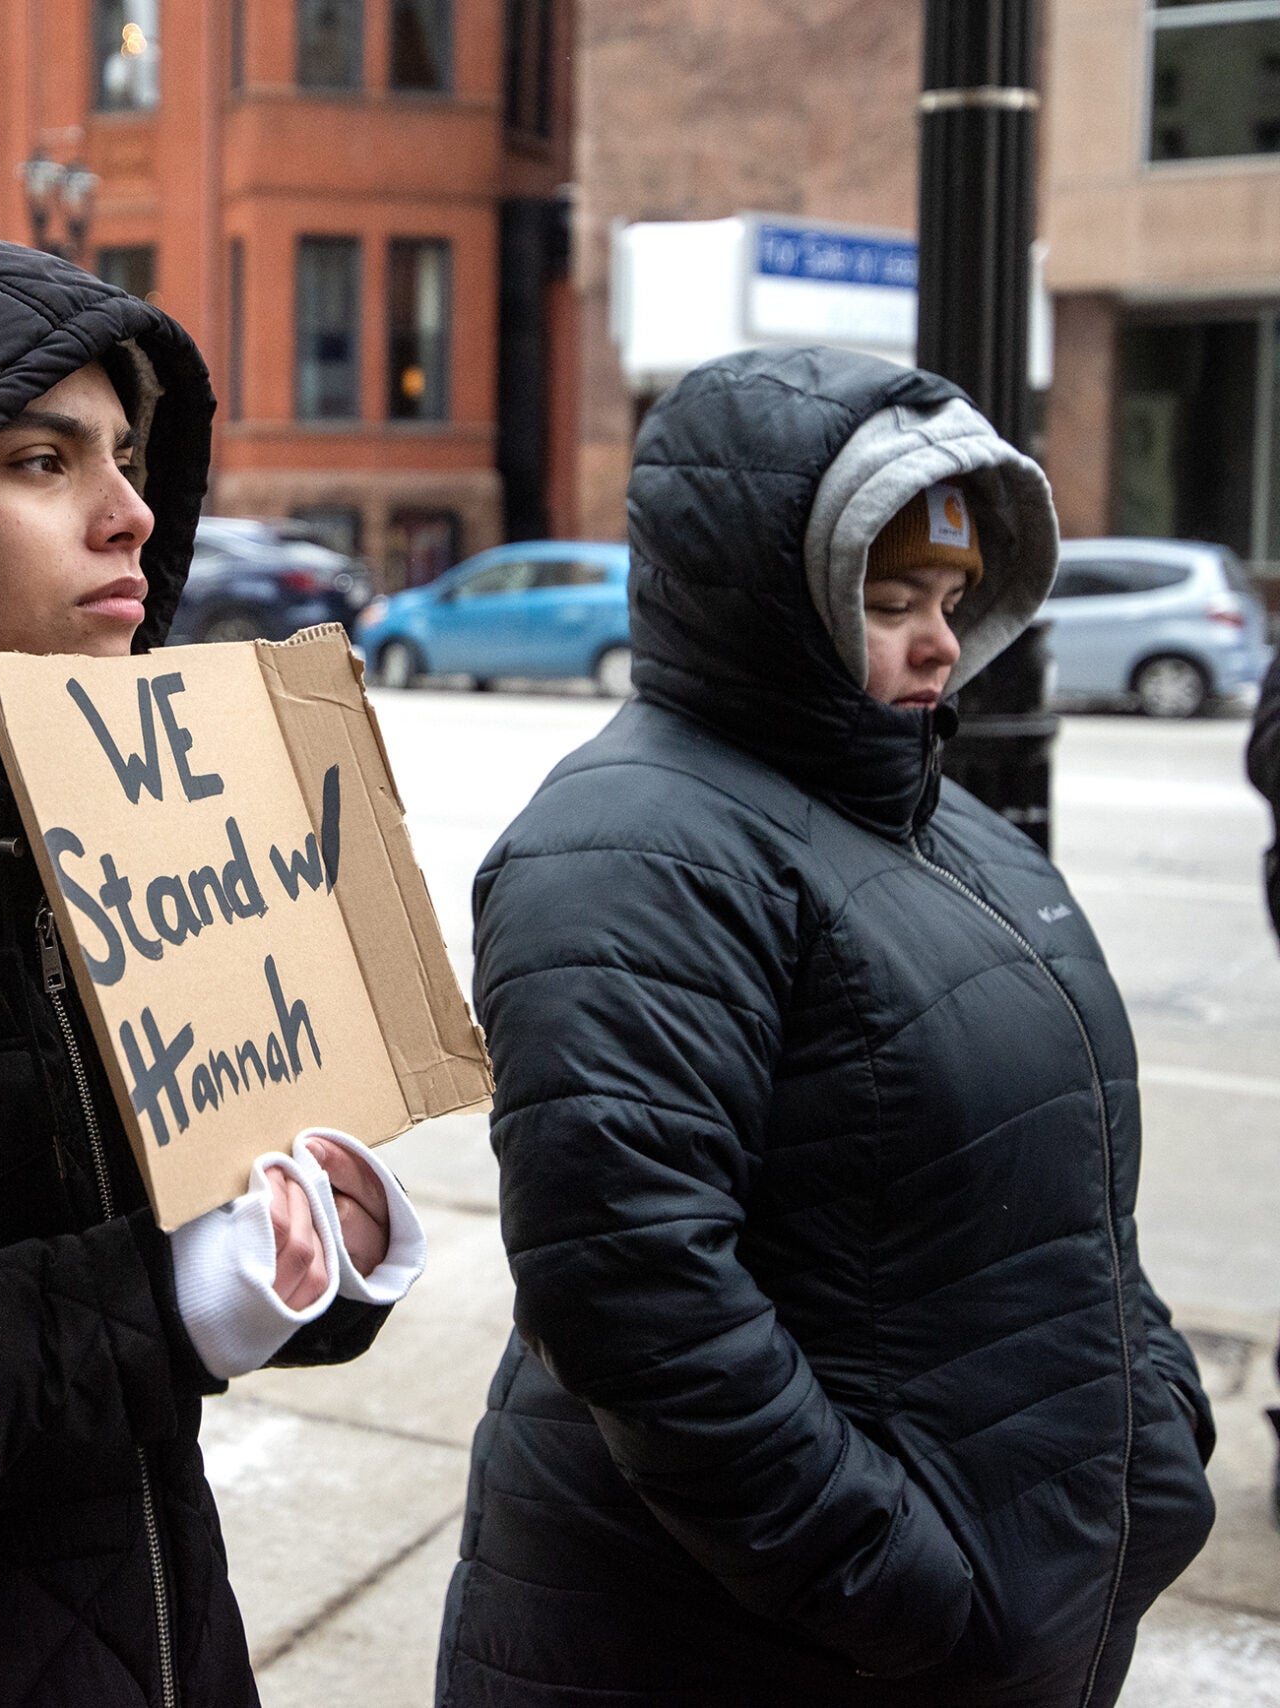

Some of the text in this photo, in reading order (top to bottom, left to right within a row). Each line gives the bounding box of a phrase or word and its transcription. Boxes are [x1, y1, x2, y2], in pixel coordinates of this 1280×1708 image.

[66, 672, 224, 804] WE
[44, 764, 341, 986] Stand w/
[120, 954, 322, 1147] Hannah
